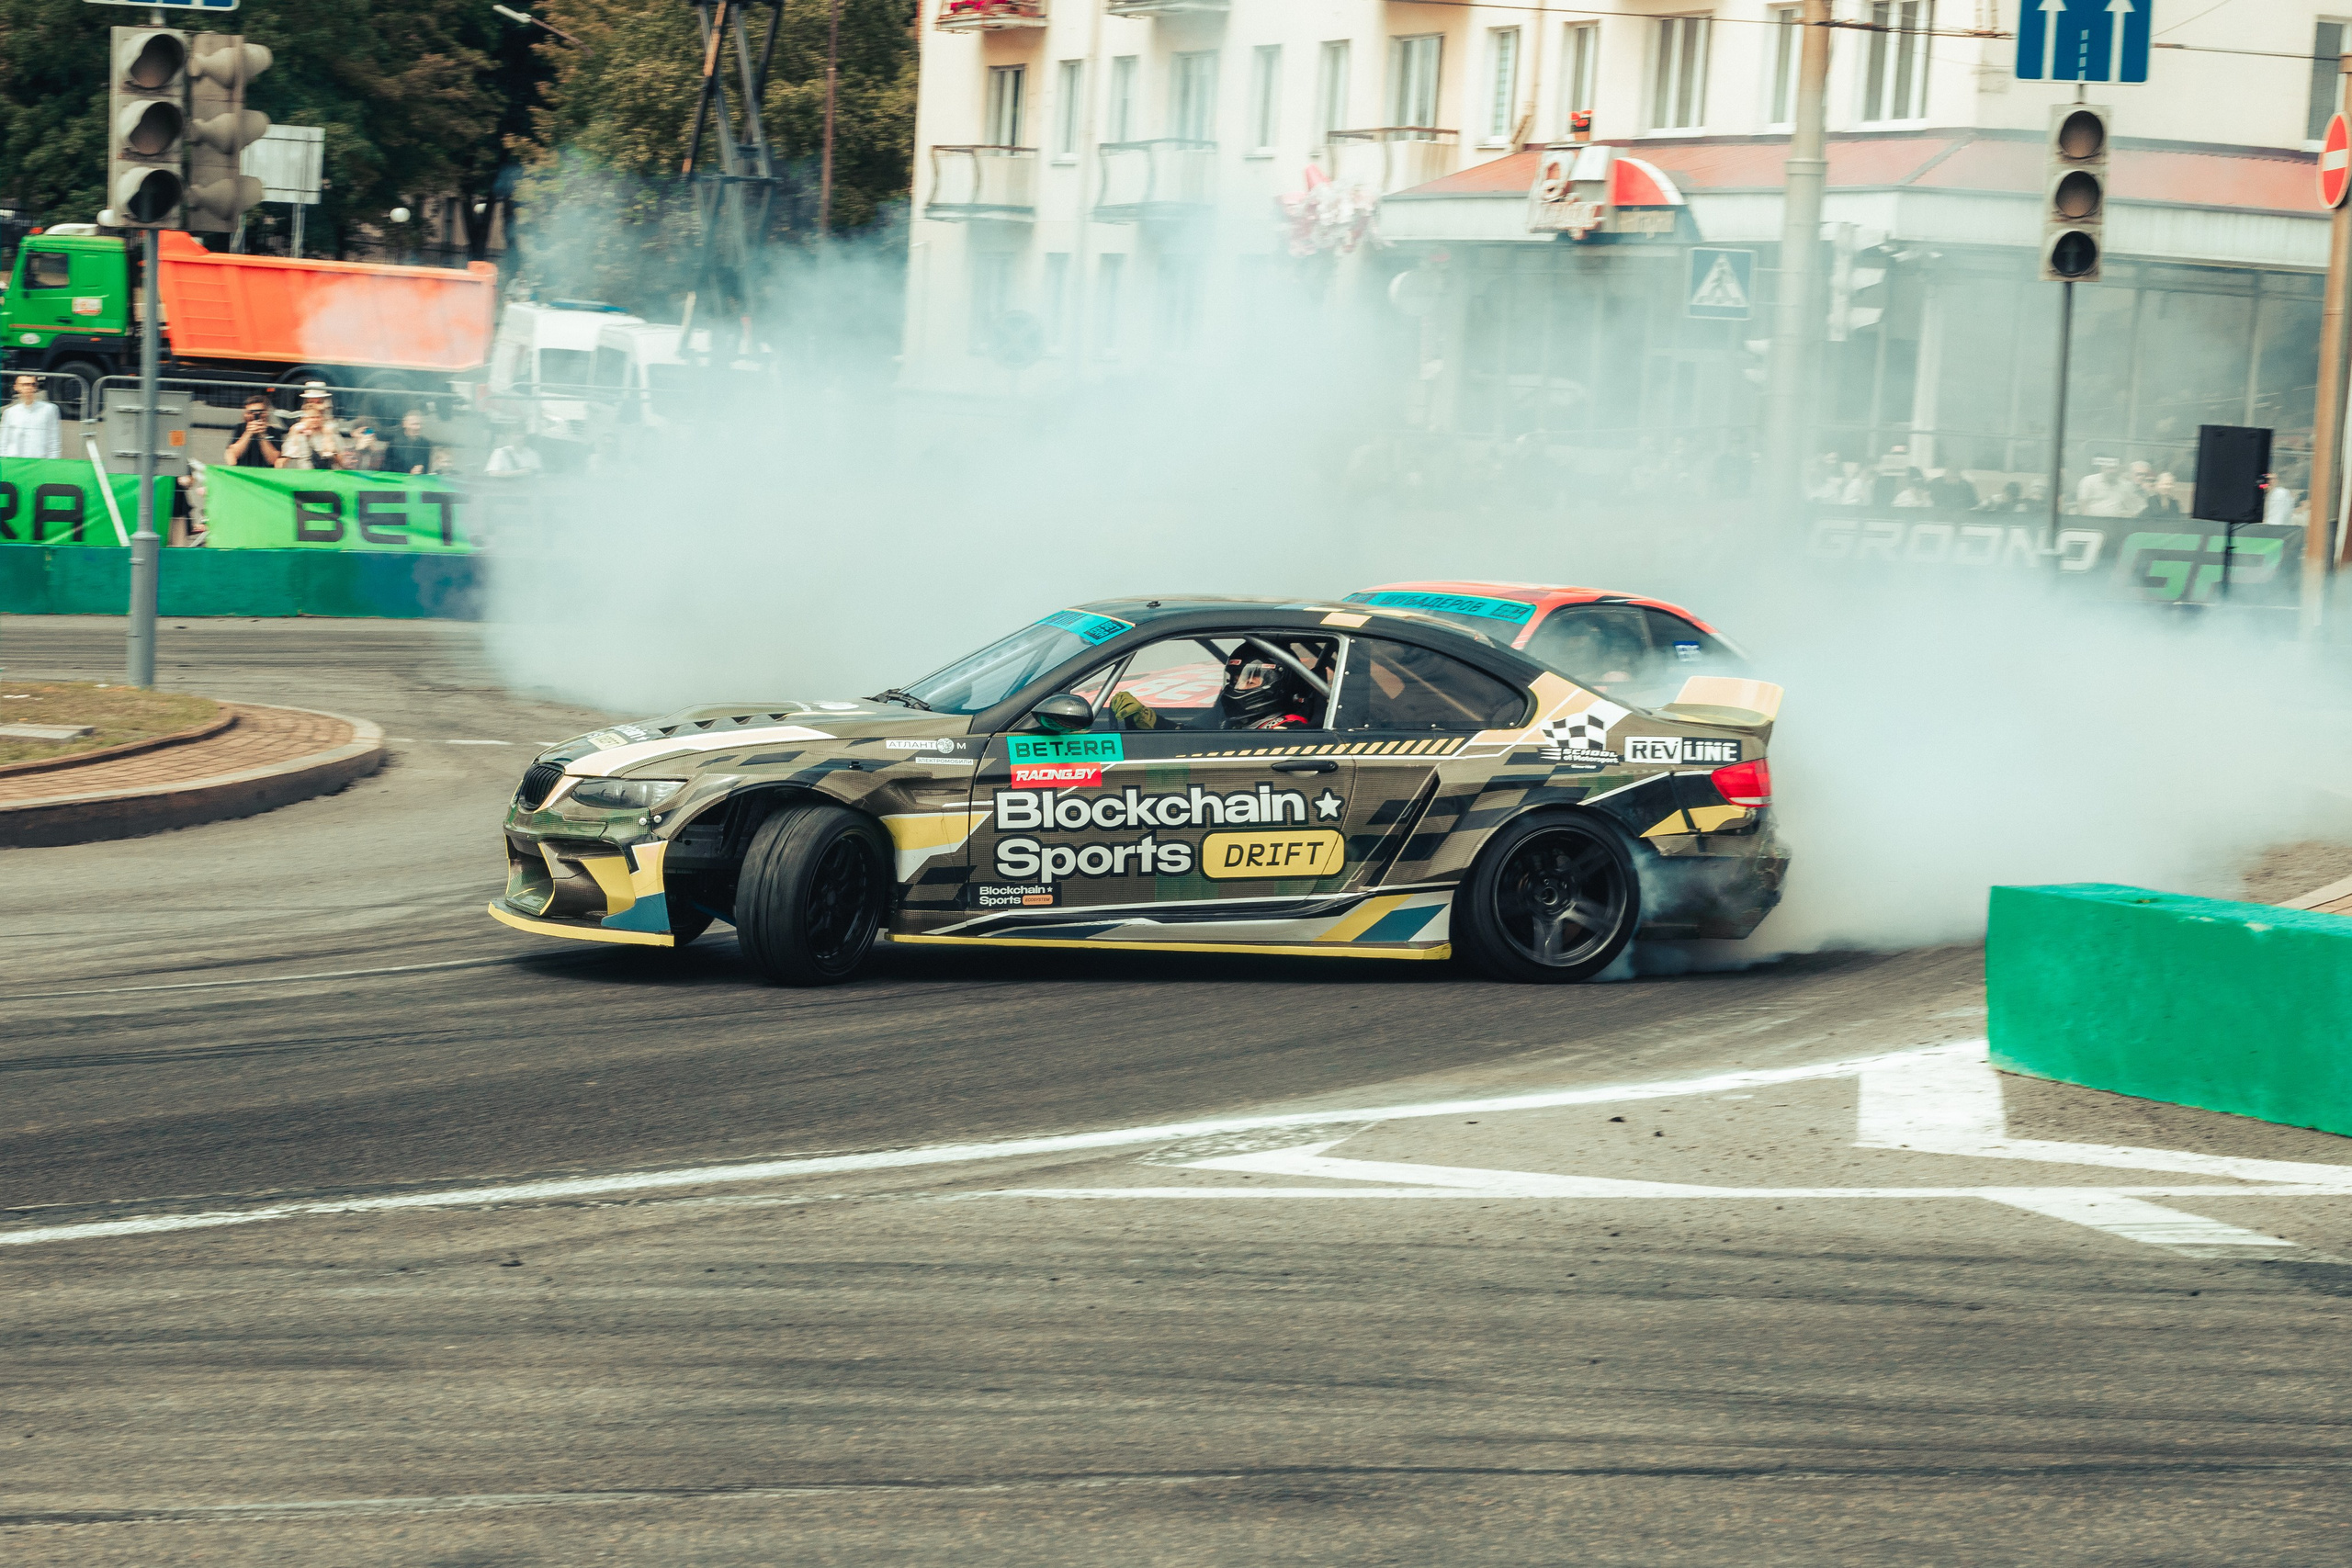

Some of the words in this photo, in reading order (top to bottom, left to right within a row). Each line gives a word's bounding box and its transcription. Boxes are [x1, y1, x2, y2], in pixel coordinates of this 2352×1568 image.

[888, 740, 934, 749] АТЛАНТ
[1015, 739, 1116, 758] BET.ERA
[1562, 748, 1619, 758] SCHOOL
[1015, 768, 1098, 782] RACING.BY
[996, 785, 1306, 829] Blockchain
[997, 834, 1193, 884] Sports
[1224, 841, 1325, 868] DRIFT
[979, 886, 1046, 895] Blockchain
[978, 896, 1022, 907] Sports
